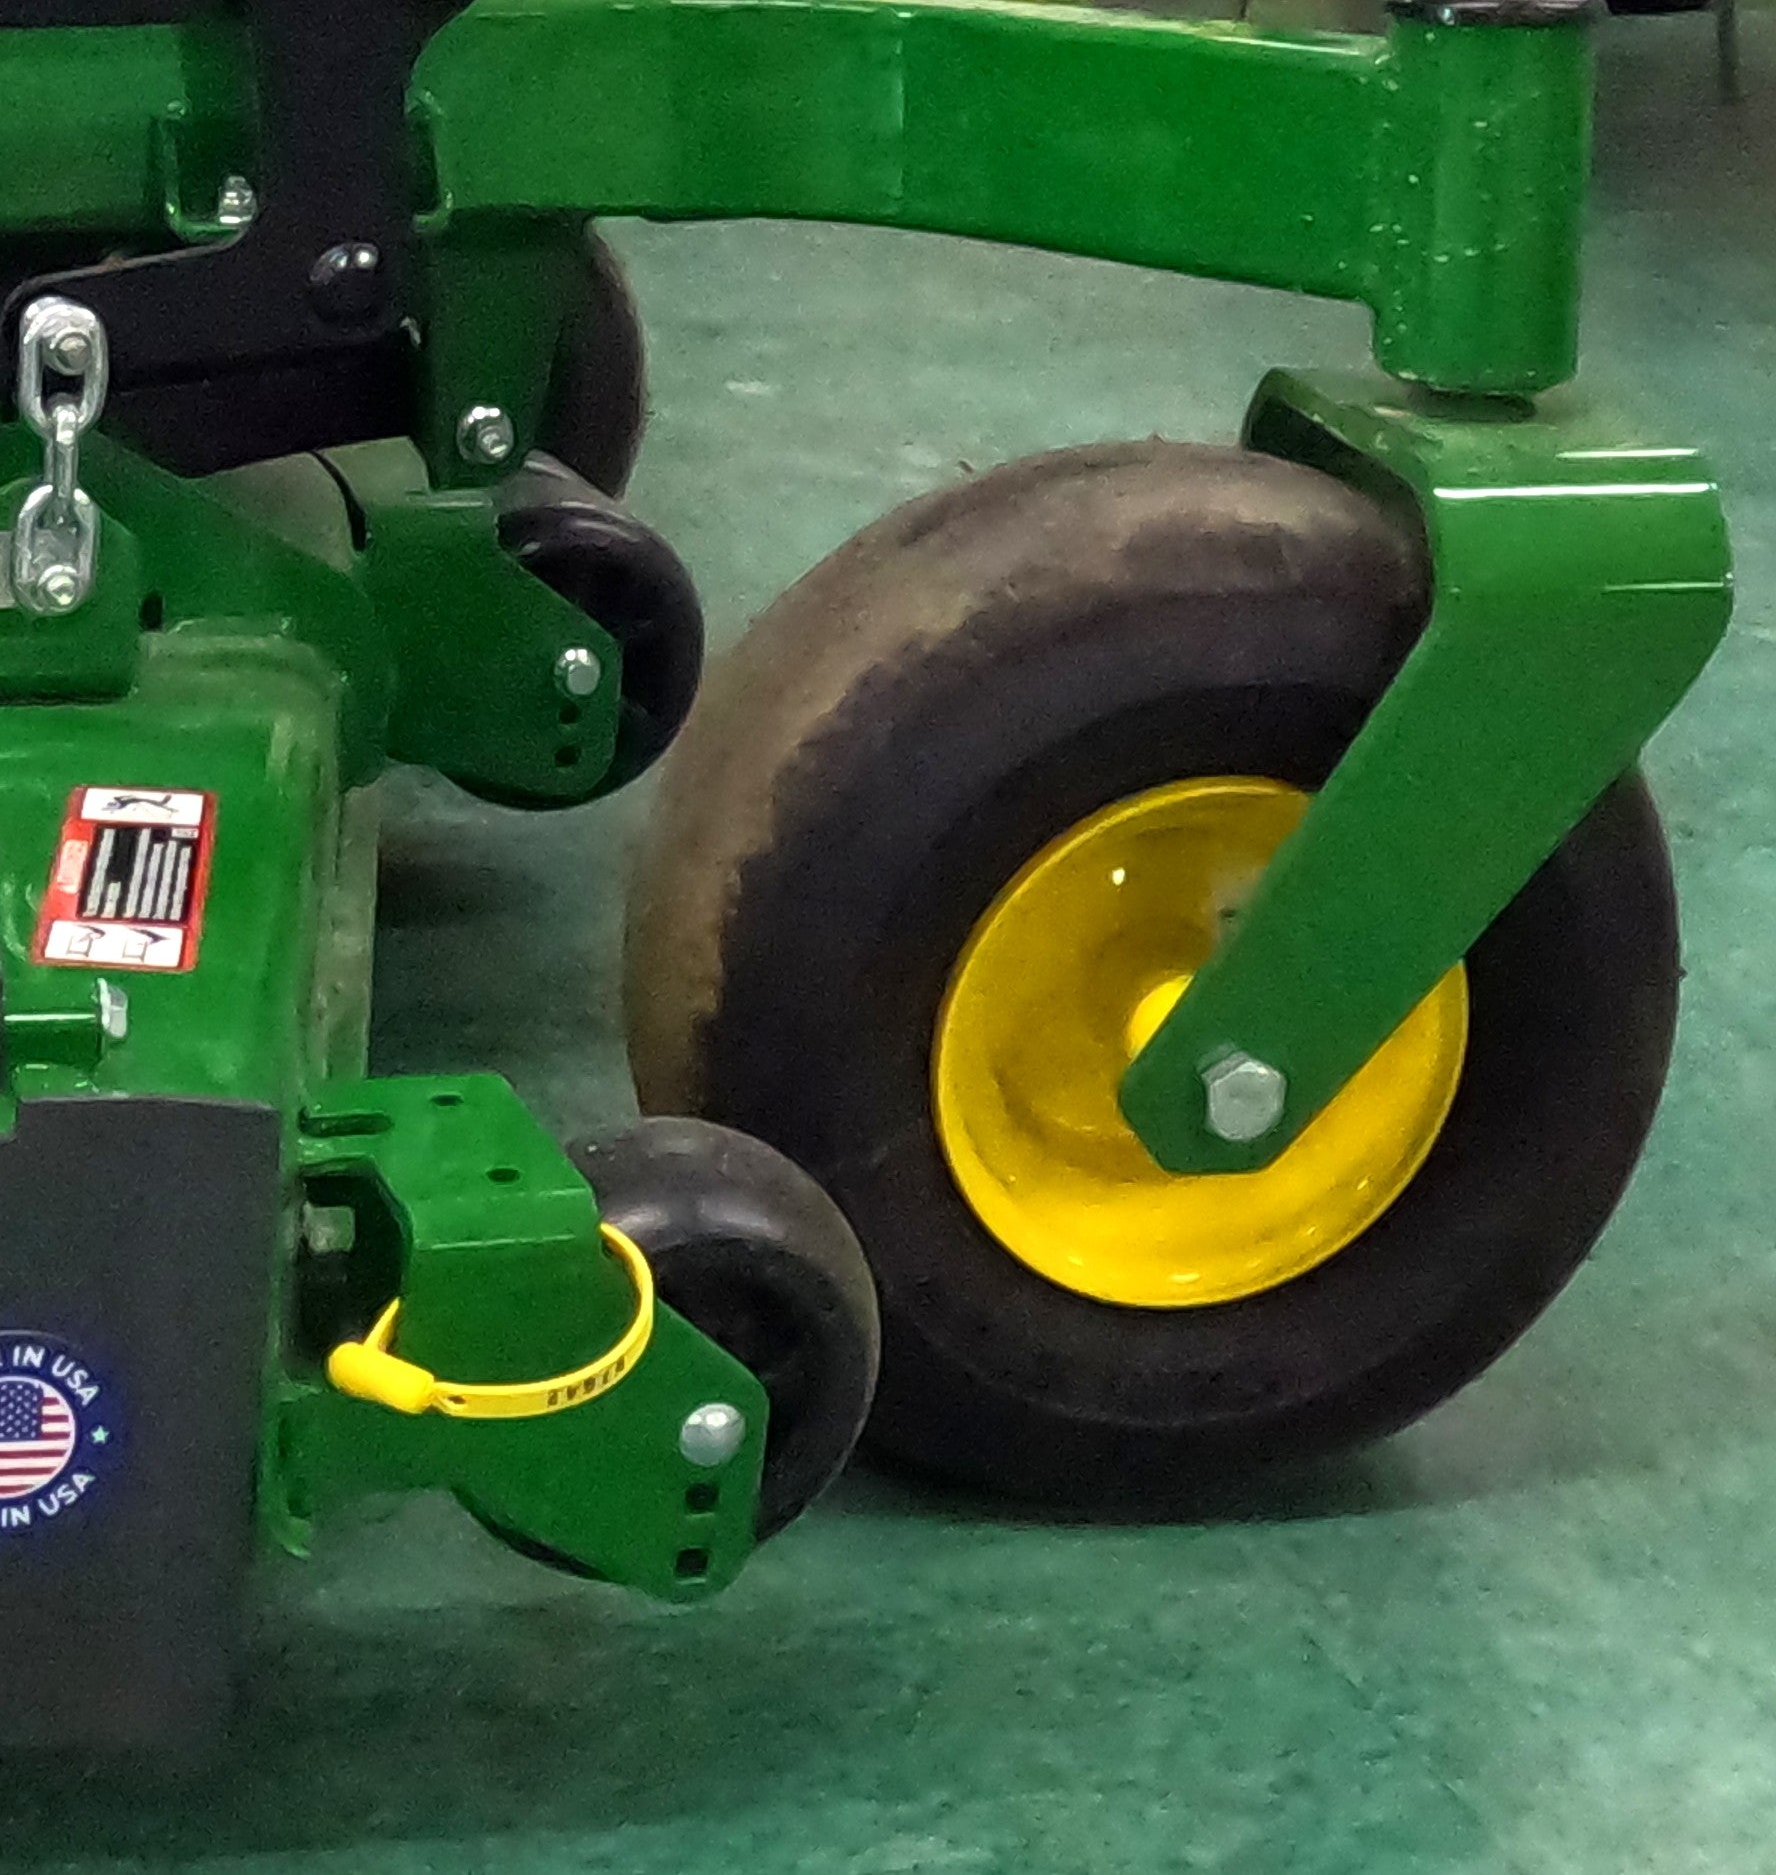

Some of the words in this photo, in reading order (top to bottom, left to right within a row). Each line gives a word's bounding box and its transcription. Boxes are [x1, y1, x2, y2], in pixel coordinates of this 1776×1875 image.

[12, 1345, 46, 1369] IN
[51, 1354, 102, 1406] USA
[0, 1505, 31, 1528] IN
[37, 1471, 97, 1517] USA
